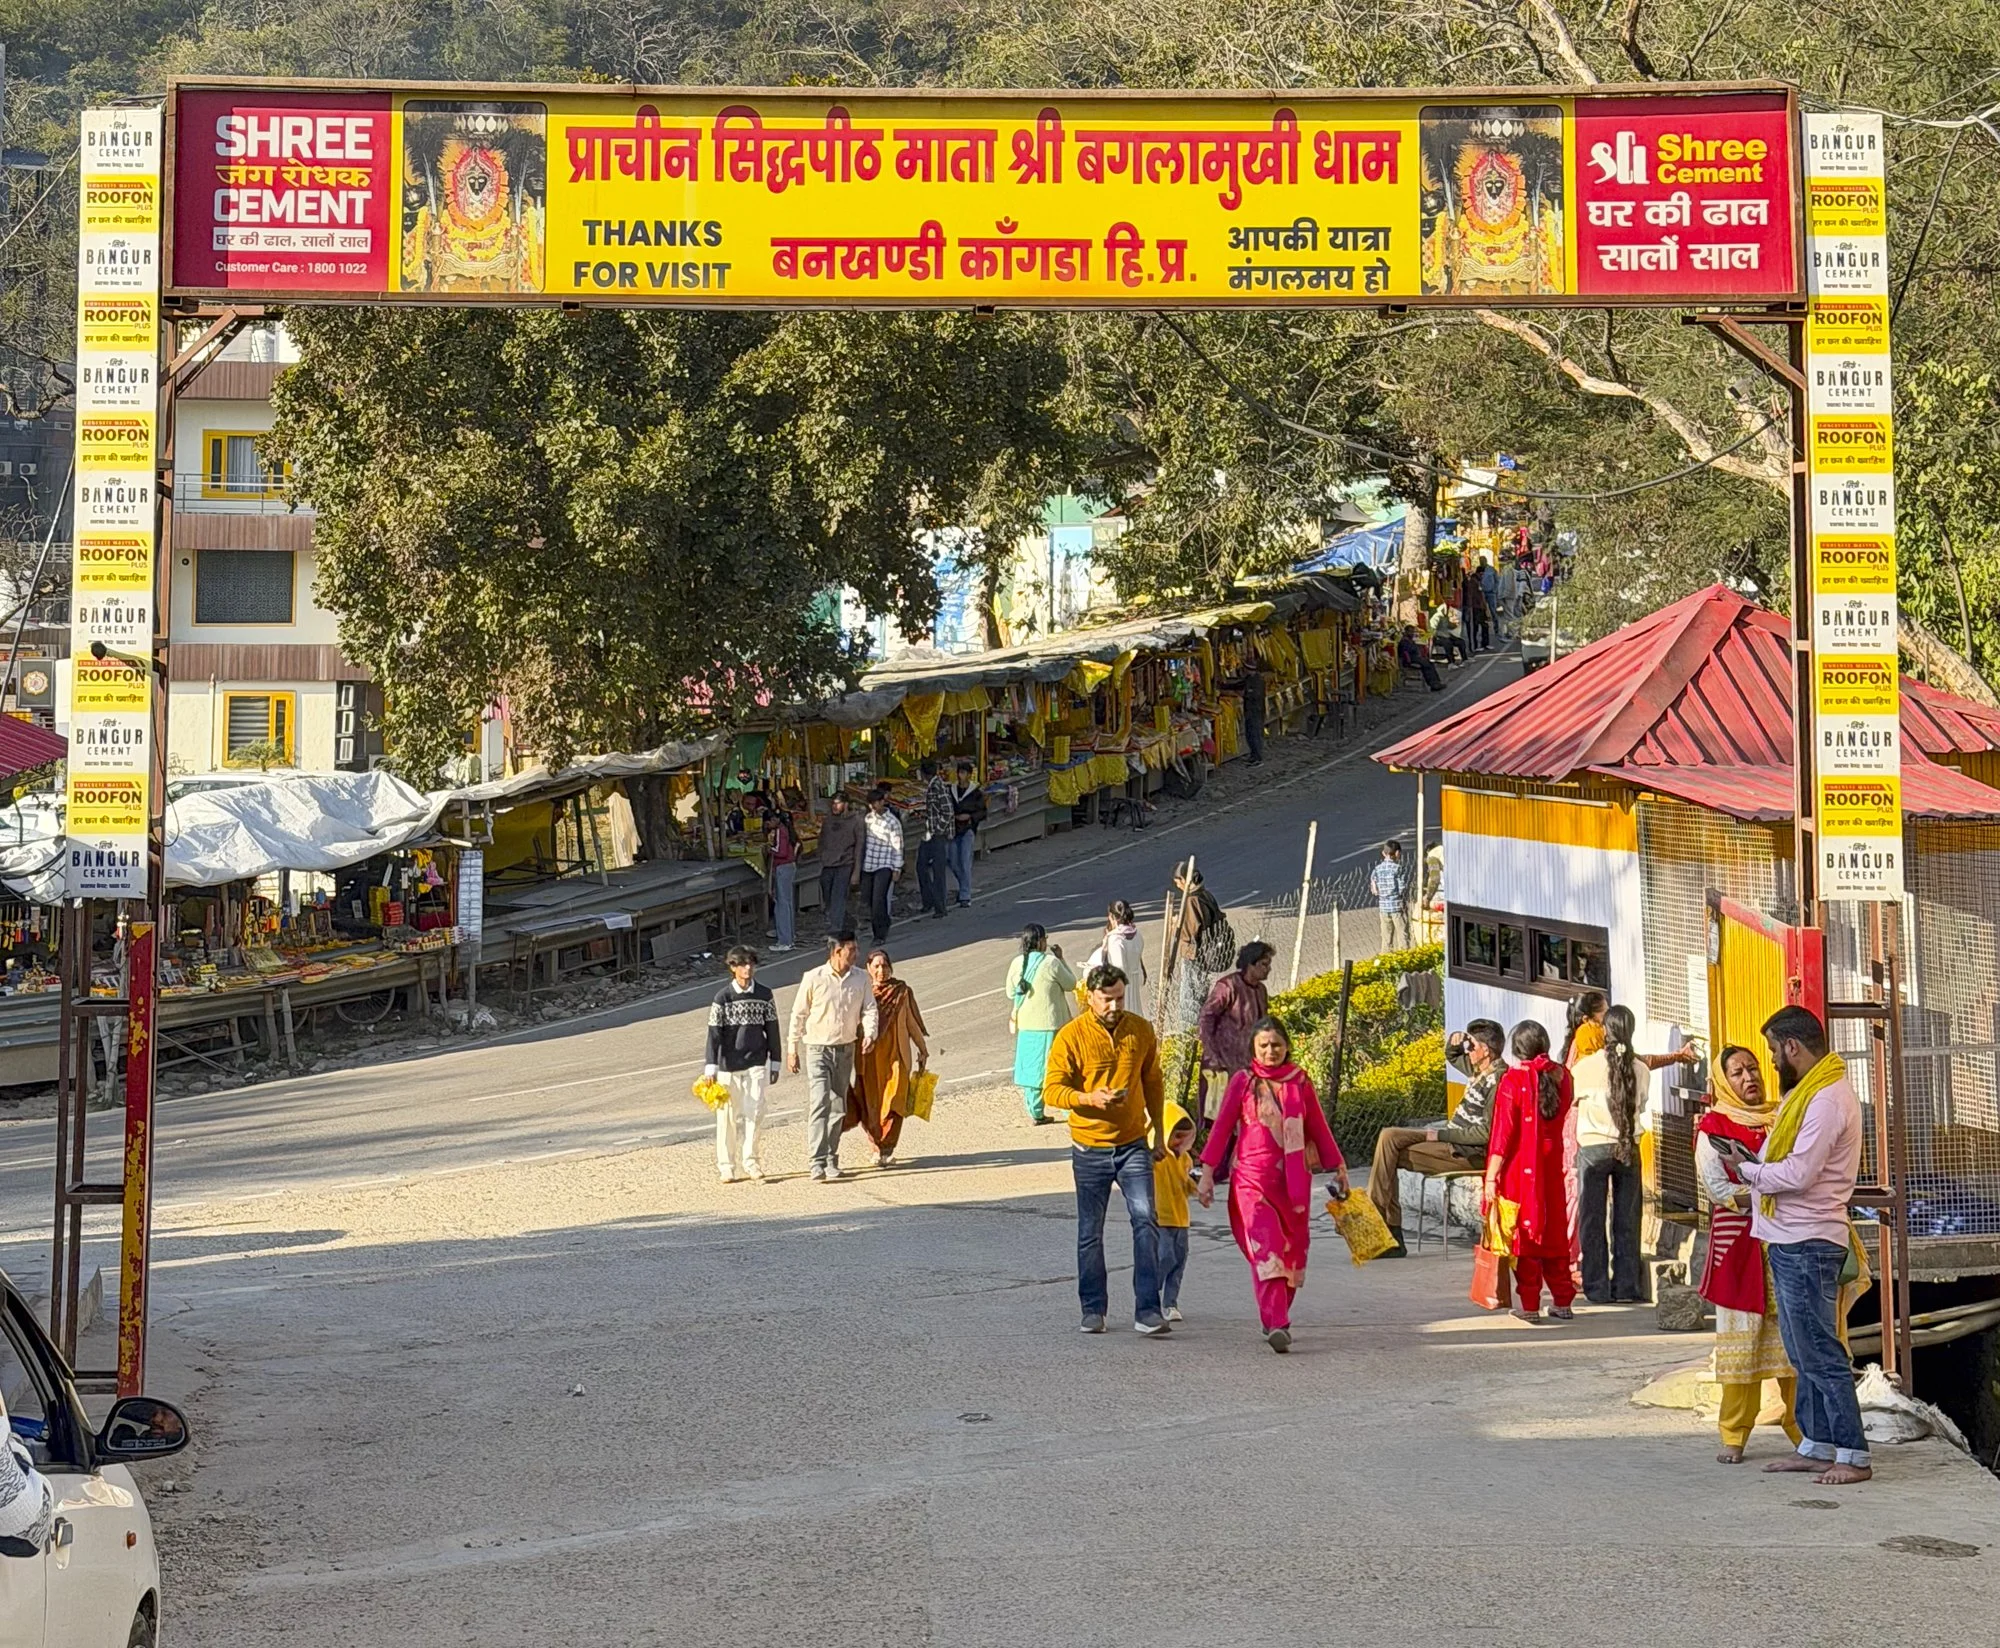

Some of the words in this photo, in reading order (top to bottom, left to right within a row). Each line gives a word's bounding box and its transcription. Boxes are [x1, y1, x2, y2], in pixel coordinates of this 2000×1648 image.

[88, 131, 152, 146] BANGUR
[216, 115, 373, 160] SHREE
[1811, 134, 1875, 149] BANGUR
[99, 149, 141, 157] CEMENT
[1657, 133, 1768, 162] Shree
[565, 104, 701, 183] प्राचीन
[711, 105, 884, 193] सिद्धपीठ
[894, 127, 998, 183] माता
[1008, 107, 1065, 184] श्री
[1075, 108, 1301, 211] बगलामुखी
[1314, 130, 1401, 184] धाम
[1822, 152, 1864, 160] CEMENT
[216, 158, 275, 187] जंग
[282, 157, 372, 188] रोधक
[1657, 162, 1763, 184] Cement
[87, 191, 153, 203] ROOFON
[1811, 194, 1878, 206] ROOFON
[214, 189, 372, 224] CEMENT
[1586, 201, 1635, 227] घर
[1643, 191, 1692, 227] की
[1701, 199, 1770, 226] ढाल
[113, 215, 122, 224] की
[1839, 218, 1848, 227] की
[583, 220, 722, 247] THANKS
[1228, 217, 1319, 251] आपकी
[1328, 227, 1391, 251] यात्रा
[215, 233, 236, 248] घर
[240, 231, 260, 246] की
[264, 233, 295, 248] ढाल,
[300, 231, 336, 248] सालों
[339, 235, 368, 250] साल
[87, 249, 151, 264] BANGUR
[771, 220, 946, 280] बनखण्डी
[1104, 222, 1197, 287] हि.प्र.
[1597, 234, 1679, 271] सालों
[1688, 243, 1760, 270] साल
[1813, 252, 1879, 268] BANGUR
[97, 267, 139, 275] CEMENT
[215, 261, 270, 274] Customer
[307, 262, 336, 274] 1800
[338, 262, 367, 274] 1022
[574, 261, 638, 288] FOR
[646, 262, 731, 289] VISIT
[1228, 257, 1354, 291] मंगलमय
[1363, 257, 1390, 293] हो
[1826, 270, 1868, 278] CEMENT
[85, 310, 150, 322] ROOFON
[1814, 312, 1882, 324] ROOFON
[110, 334, 120, 342] की
[1842, 337, 1852, 345] की
[84, 368, 149, 383] BANGUR
[1817, 371, 1882, 386] BANGUR
[95, 386, 137, 394] CEMENT
[1829, 388, 1871, 396] CEMENT
[82, 429, 149, 441] ROOFON
[1818, 431, 1885, 444] ROOFON
[108, 453, 118, 462] की
[1845, 456, 1855, 464] की
[82, 488, 147, 503] BANGUR
[1820, 490, 1886, 505] BANGUR
[93, 505, 136, 513] CEMENT
[1832, 508, 1875, 516] CEMENT
[80, 549, 147, 561] ROOFON
[1821, 551, 1889, 563] ROOFON
[107, 573, 116, 582] की
[1848, 576, 1858, 584] की
[80, 608, 145, 623] BANGUR
[1823, 610, 1889, 625] BANGUR
[91, 625, 133, 634] CEMENT
[1834, 628, 1877, 636] CEMENT
[78, 670, 146, 682] ROOFON
[1823, 672, 1891, 684] ROOFON
[104, 694, 113, 702] की
[1850, 696, 1860, 705] की
[77, 729, 142, 744] BANGUR
[1825, 731, 1891, 746] BANGUR
[88, 747, 130, 755] CEMENT
[1836, 749, 1880, 757] CEMENT
[74, 791, 142, 803] ROOFON
[1825, 793, 1893, 806] ROOFON
[100, 815, 109, 825] की
[1852, 818, 1862, 826] की
[72, 850, 139, 867] BANGUR
[1827, 853, 1894, 869] BANGUR
[83, 869, 127, 877] CEMENT
[1839, 871, 1882, 879] CEMENT
